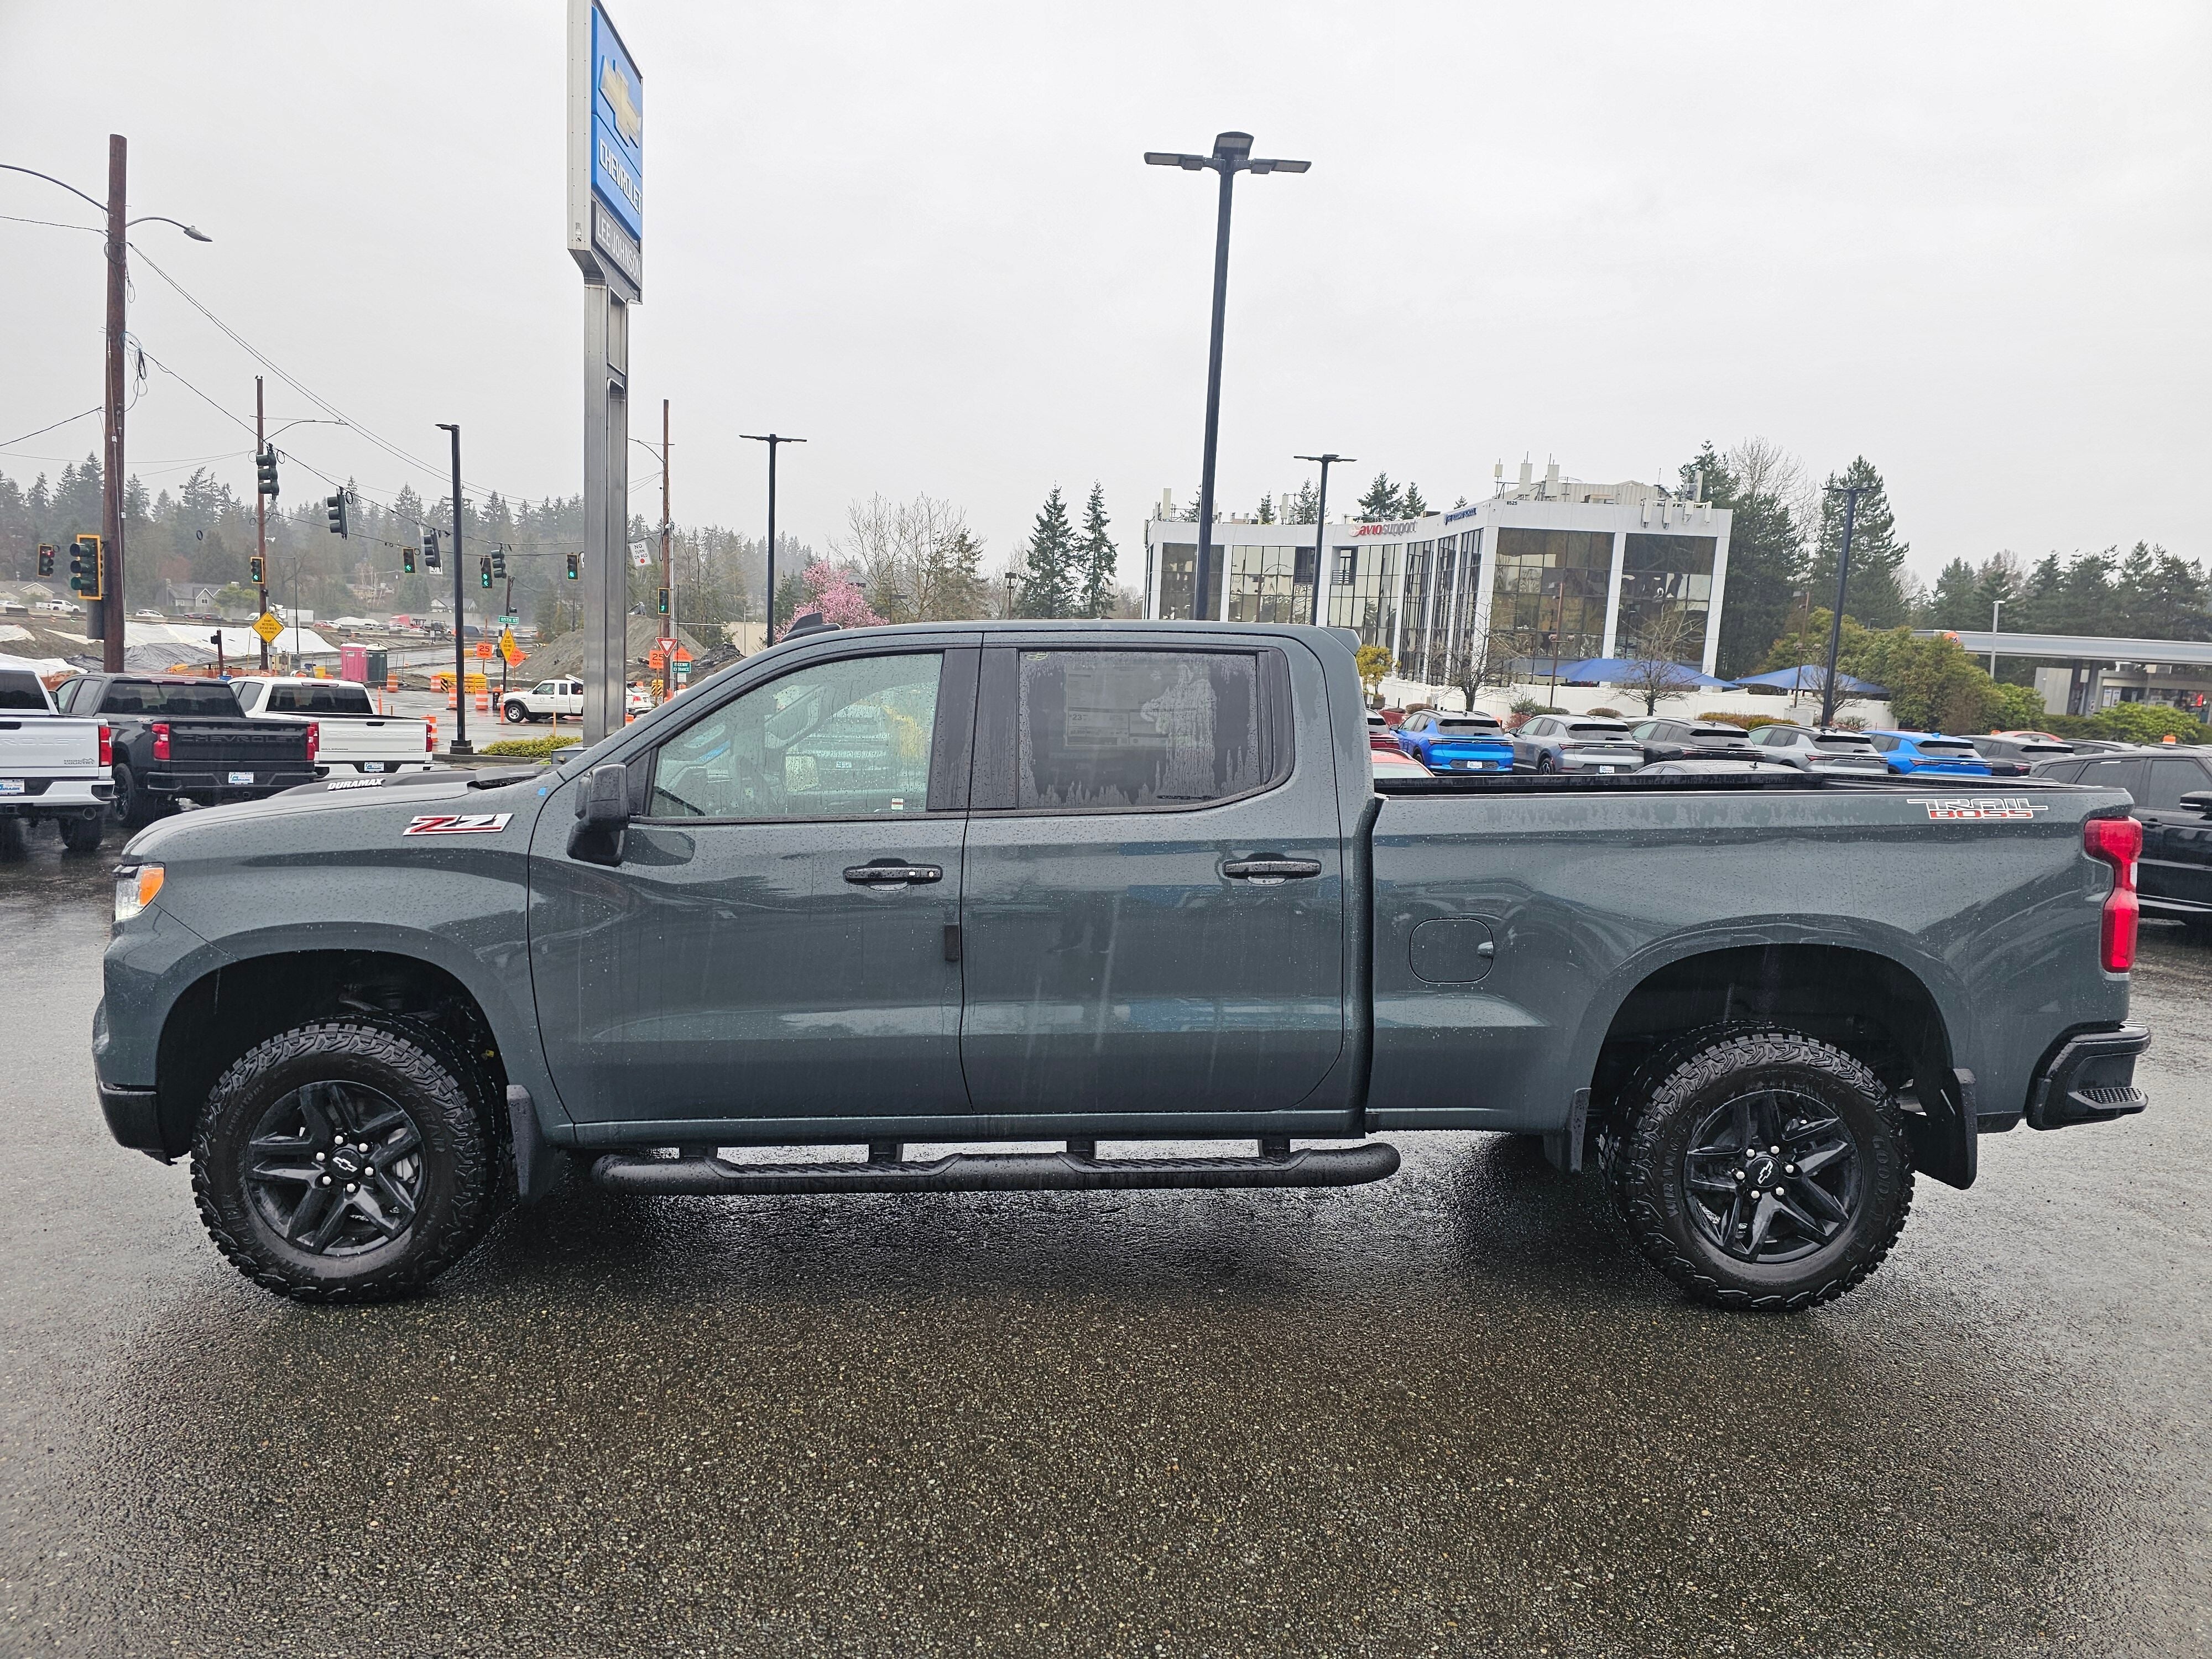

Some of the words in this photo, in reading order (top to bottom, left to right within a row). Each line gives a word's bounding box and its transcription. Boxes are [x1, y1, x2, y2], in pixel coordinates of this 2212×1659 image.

[599, 138, 642, 215] CHEVROLET
[597, 212, 611, 248] LEE
[612, 231, 641, 281] JOHNSON
[327, 778, 386, 791] DURAMAX
[1907, 799, 2048, 811] TRAIL
[1929, 808, 2034, 819] BOSS
[403, 813, 514, 836] Z71
[1662, 1099, 1707, 1218] WRANGLER
